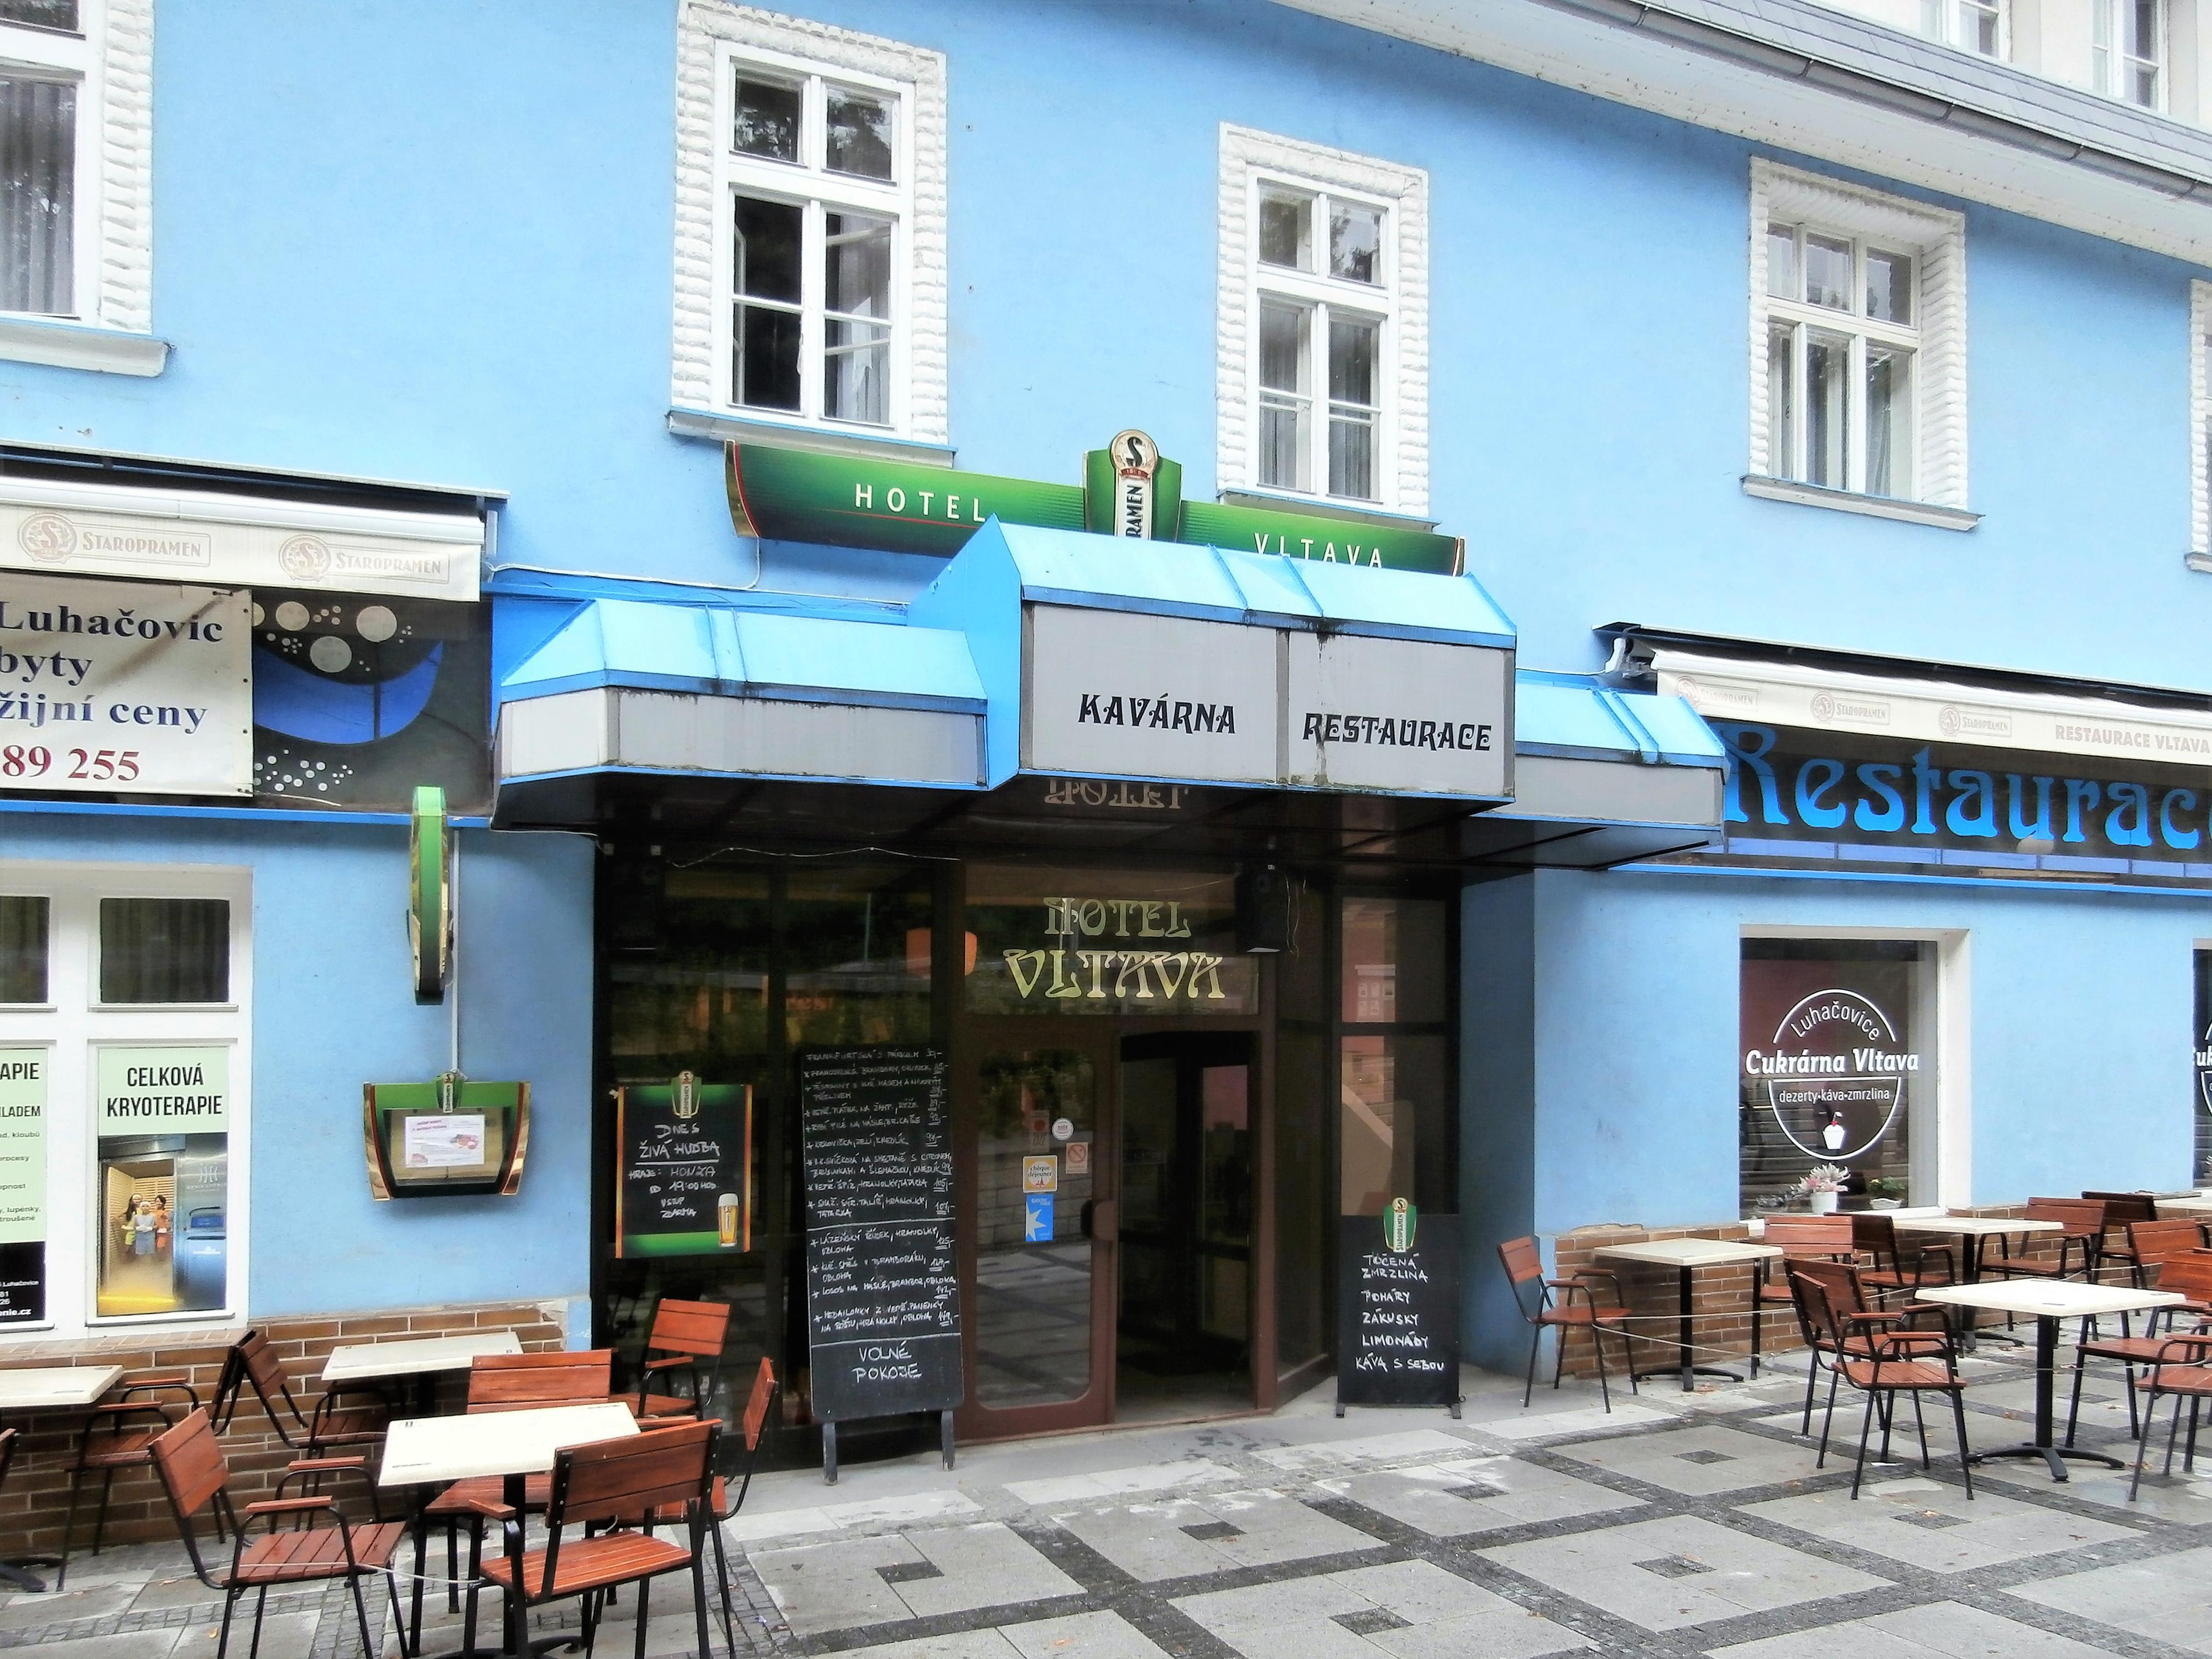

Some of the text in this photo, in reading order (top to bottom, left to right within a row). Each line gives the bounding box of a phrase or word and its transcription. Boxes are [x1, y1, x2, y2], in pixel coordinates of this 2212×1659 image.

[855, 483, 986, 523] HOTEL
[83, 531, 201, 557] STAROPRAMEN
[1254, 532, 1383, 569] VLTAVA
[336, 552, 441, 575] STAROPRAMEN
[0, 601, 223, 643] Luhačovic
[0, 645, 93, 686] byty
[109, 703, 207, 734] ceny
[1078, 692, 1237, 735] KAVÁRNA
[1836, 702, 1886, 719] STAROPRAMEN
[1303, 712, 1493, 752] RESTAURACE
[1961, 715, 2008, 732] STAROPRAMEN
[2055, 724, 2211, 754] RESTAURACE VLTAVA
[2, 744, 140, 781] 89 255
[1713, 721, 2212, 850] Restaurac
[1043, 896, 1192, 938] HOTEL
[1003, 949, 1226, 1000] VLTAVA
[1790, 1000, 1880, 1041] Luhačovice
[1745, 1047, 1919, 1074] Cukrárna Vltava
[127, 1062, 204, 1087] CELKOVÁ
[0, 1105, 41, 1118] LADEM
[107, 1095, 223, 1118] KRYOTERAPIE
[654, 1123, 701, 1139] DNES
[638, 1139, 721, 1160] ŽIVÁ HUDBA
[1362, 1251, 1420, 1270] TOČENÁ
[1361, 1267, 1429, 1284] ZMRZLINA
[1360, 1287, 1411, 1305] POHÁRY
[1361, 1307, 1419, 1326] ZÁKUSKY
[858, 1340, 912, 1363] VOLNÉ
[1361, 1330, 1429, 1349] LIMONÁDY
[851, 1362, 923, 1384] POKOJE
[1355, 1352, 1446, 1373] KÁVA S SEBOU
